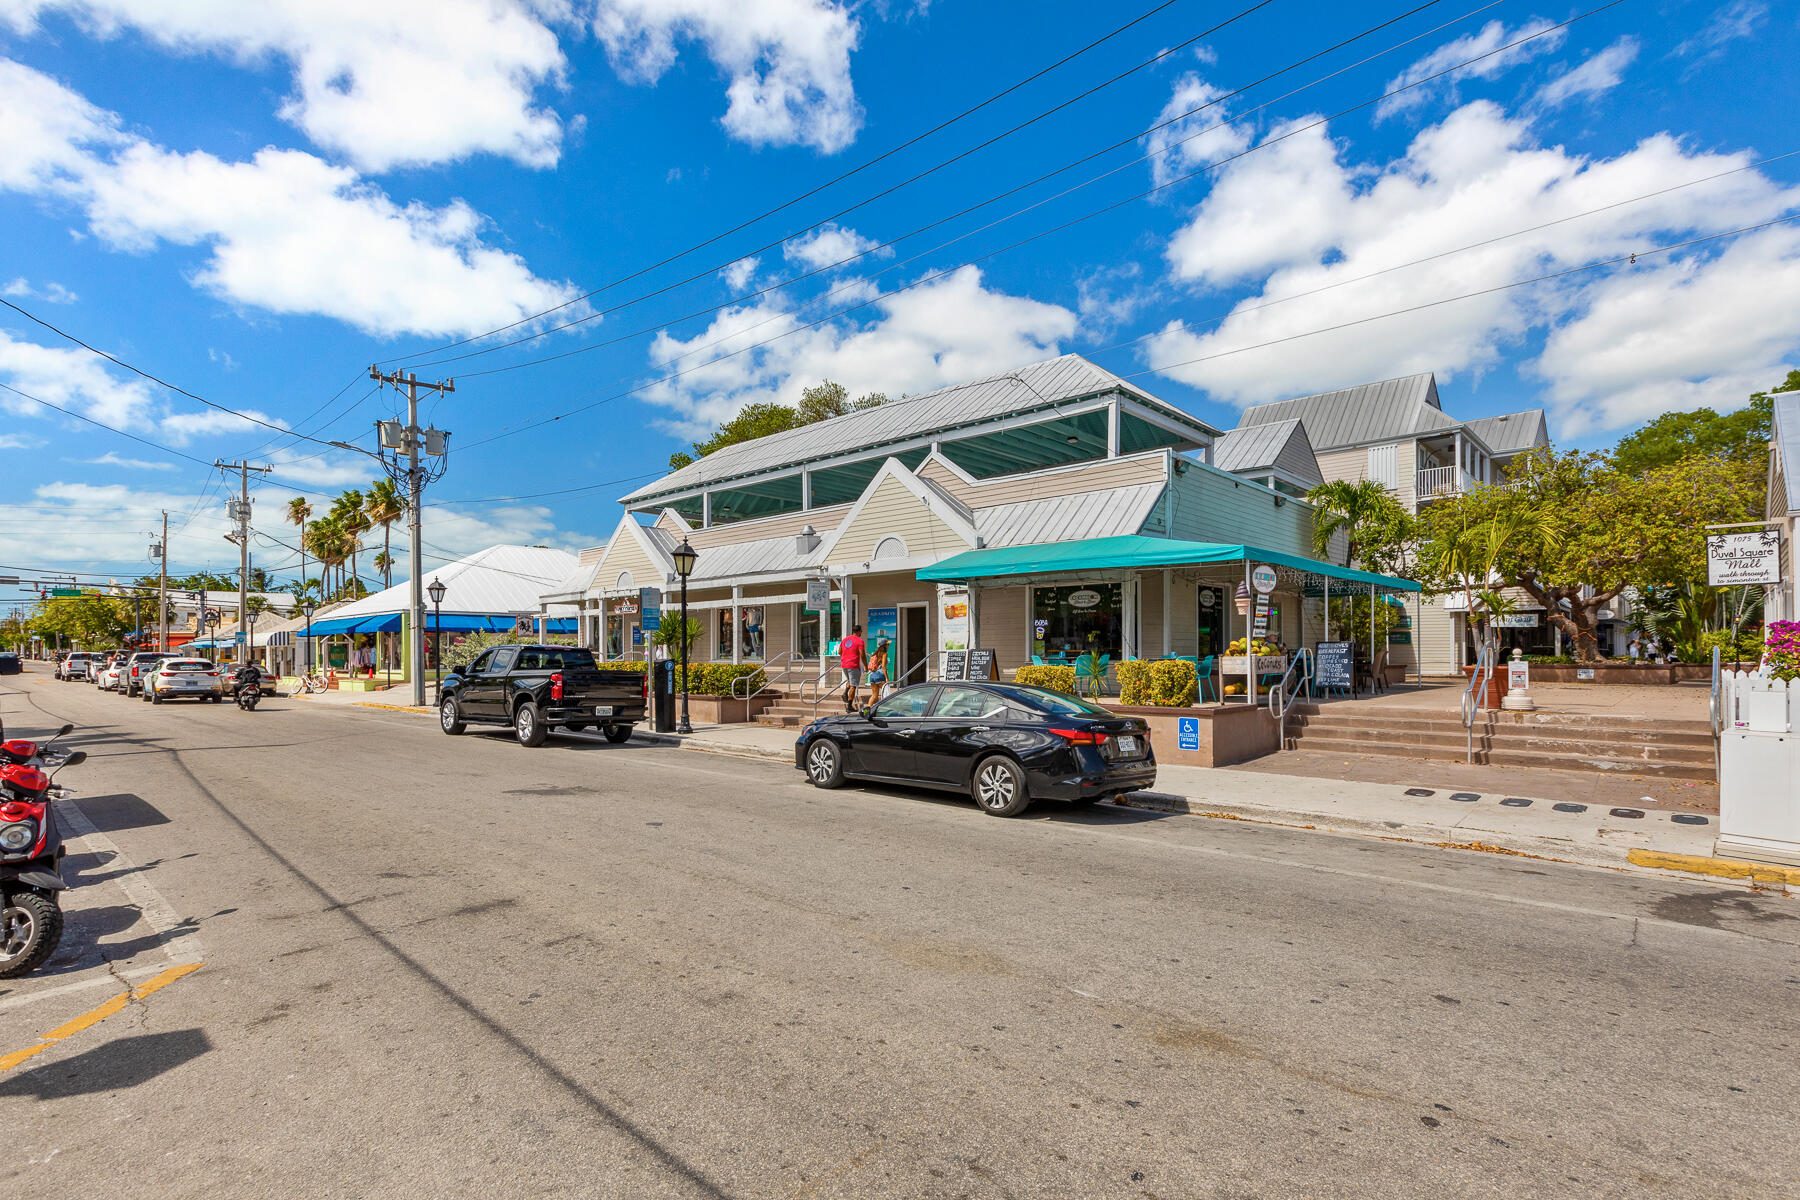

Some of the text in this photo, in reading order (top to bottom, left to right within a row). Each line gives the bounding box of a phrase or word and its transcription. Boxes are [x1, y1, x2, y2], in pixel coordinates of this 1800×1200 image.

[1711, 547, 1774, 559] Duval Square
[1725, 559, 1762, 569] Mall
[1718, 569, 1769, 578] walk through
[1034, 619, 1048, 627] BOBA
